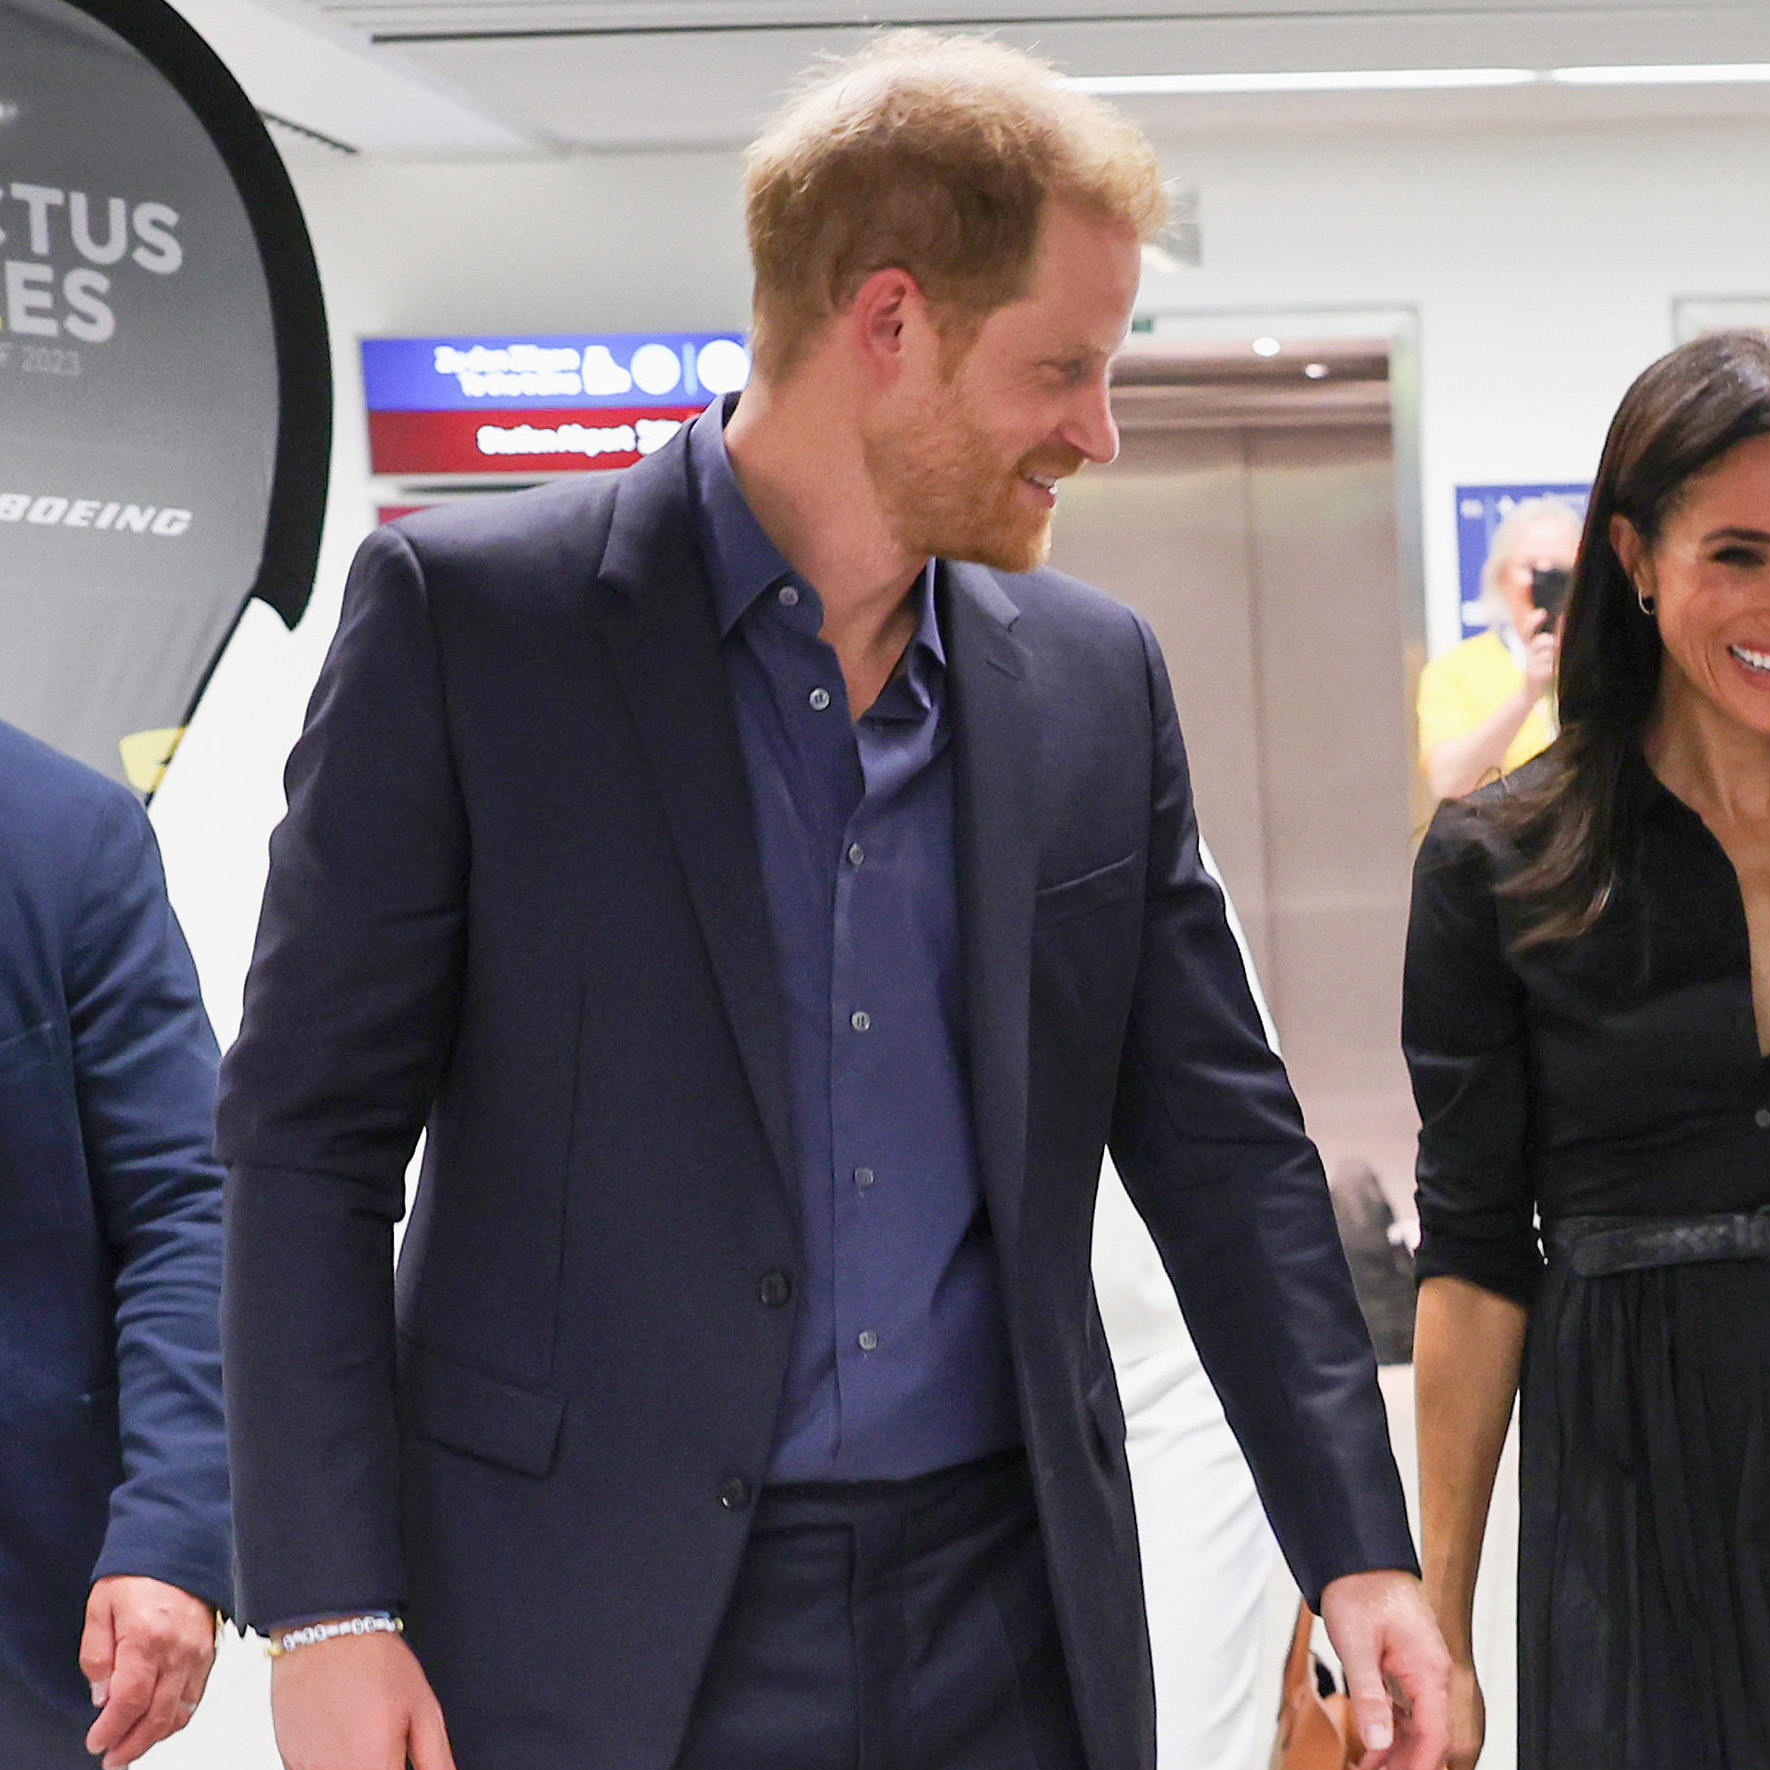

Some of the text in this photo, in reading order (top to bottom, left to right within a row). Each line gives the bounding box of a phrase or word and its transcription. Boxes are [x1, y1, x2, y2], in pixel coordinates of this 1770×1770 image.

[0, 183, 183, 274] TUS
[0, 261, 116, 343] ES
[0, 494, 192, 537] BOEING
